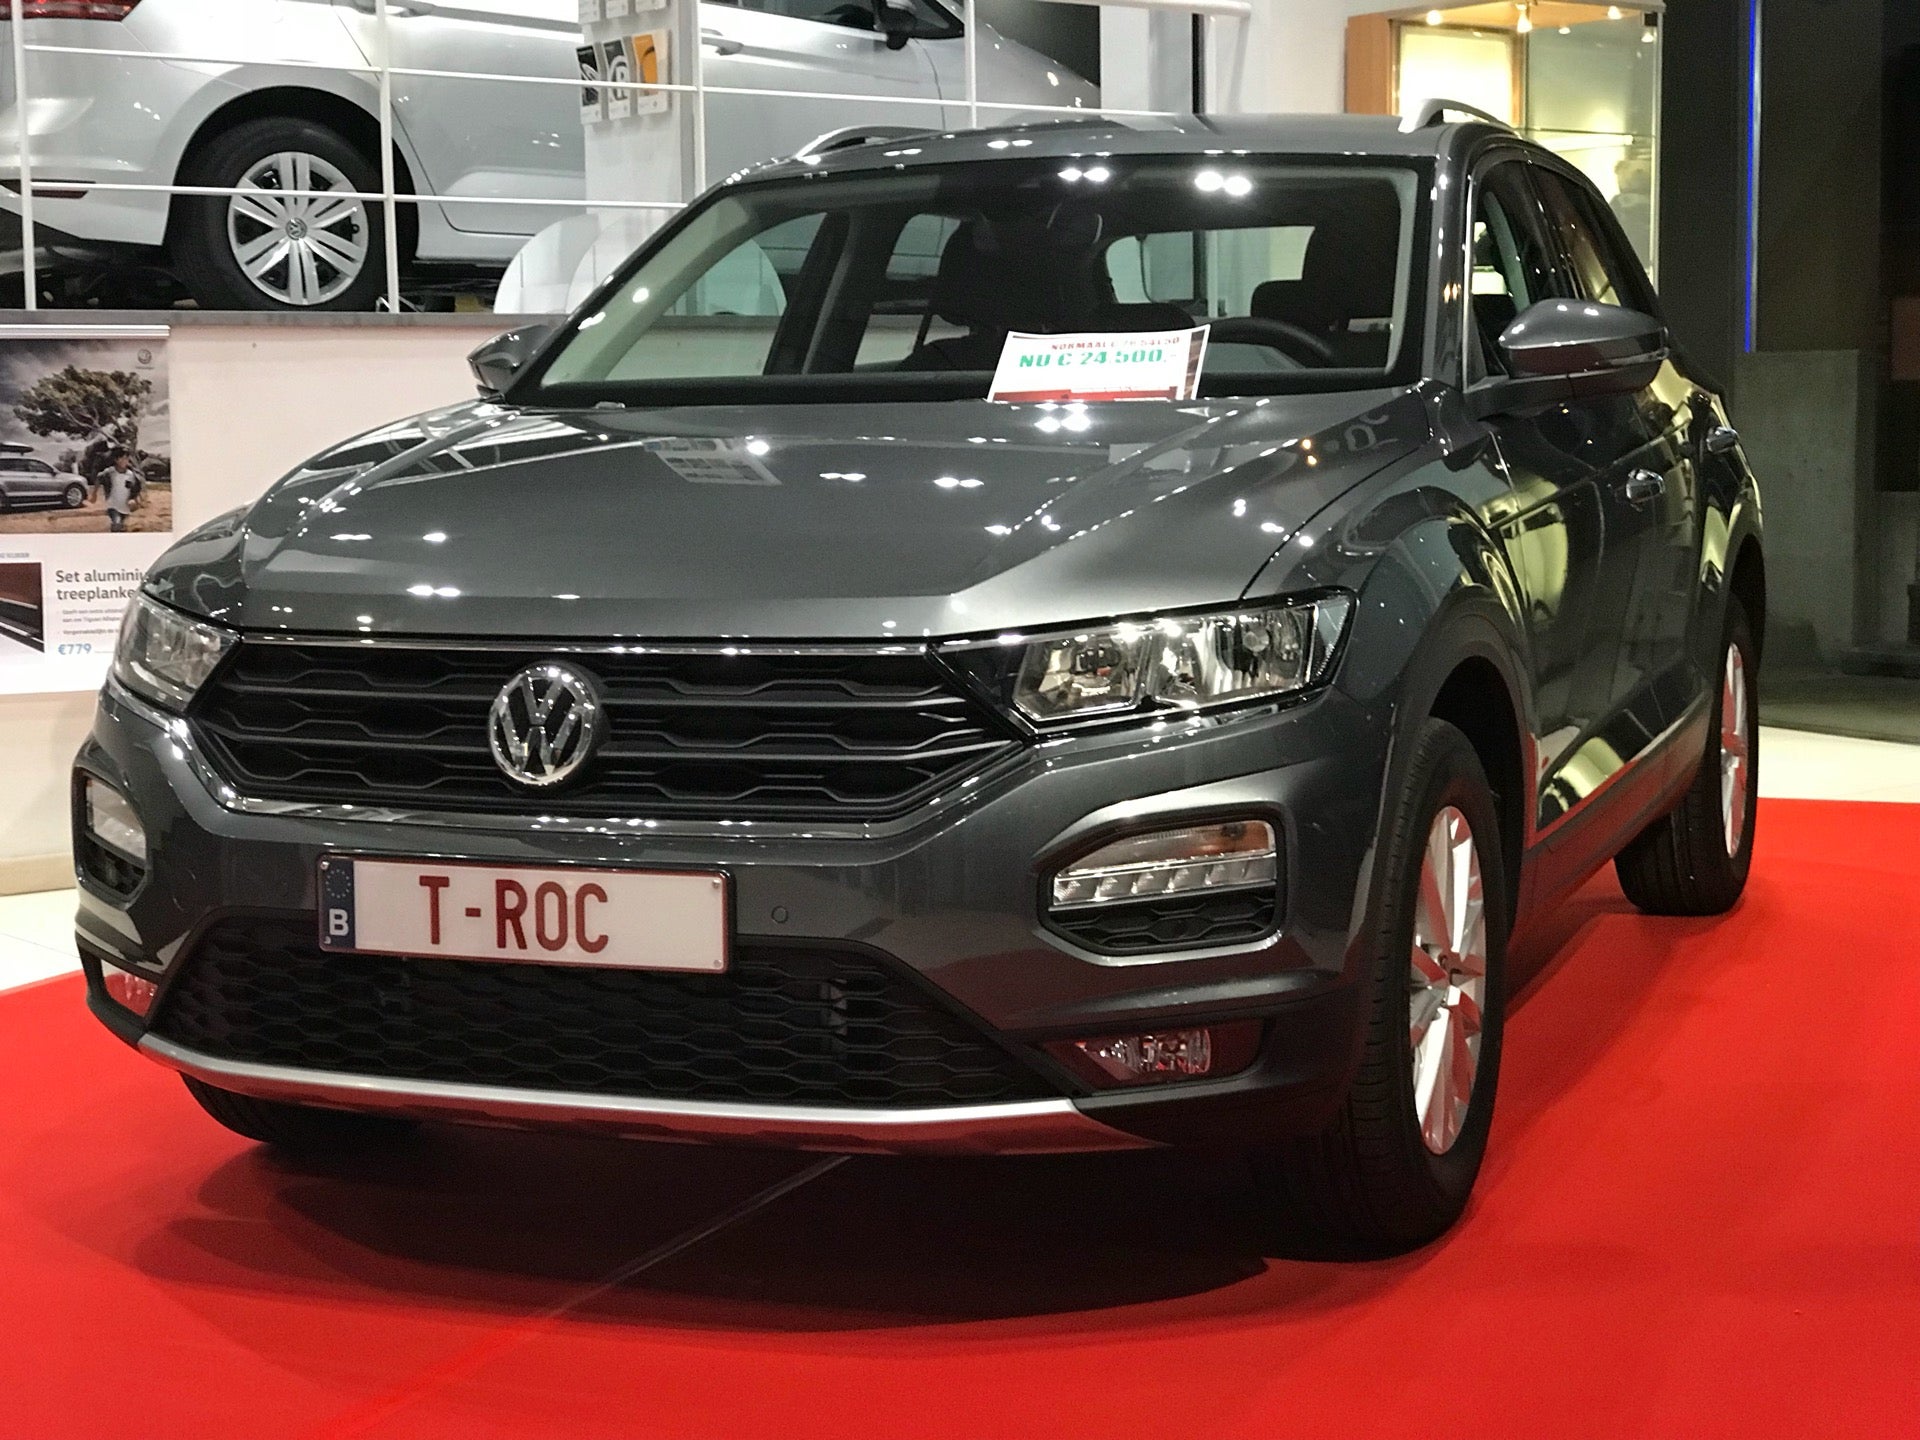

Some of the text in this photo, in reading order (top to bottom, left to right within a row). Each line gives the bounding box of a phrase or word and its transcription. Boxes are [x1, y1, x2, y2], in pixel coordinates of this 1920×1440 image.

[1019, 354, 1051, 367] NU
[56, 570, 80, 583] Set
[58, 643, 92, 655] €779
[419, 875, 609, 954] T-ROC
[328, 908, 349, 936] B
